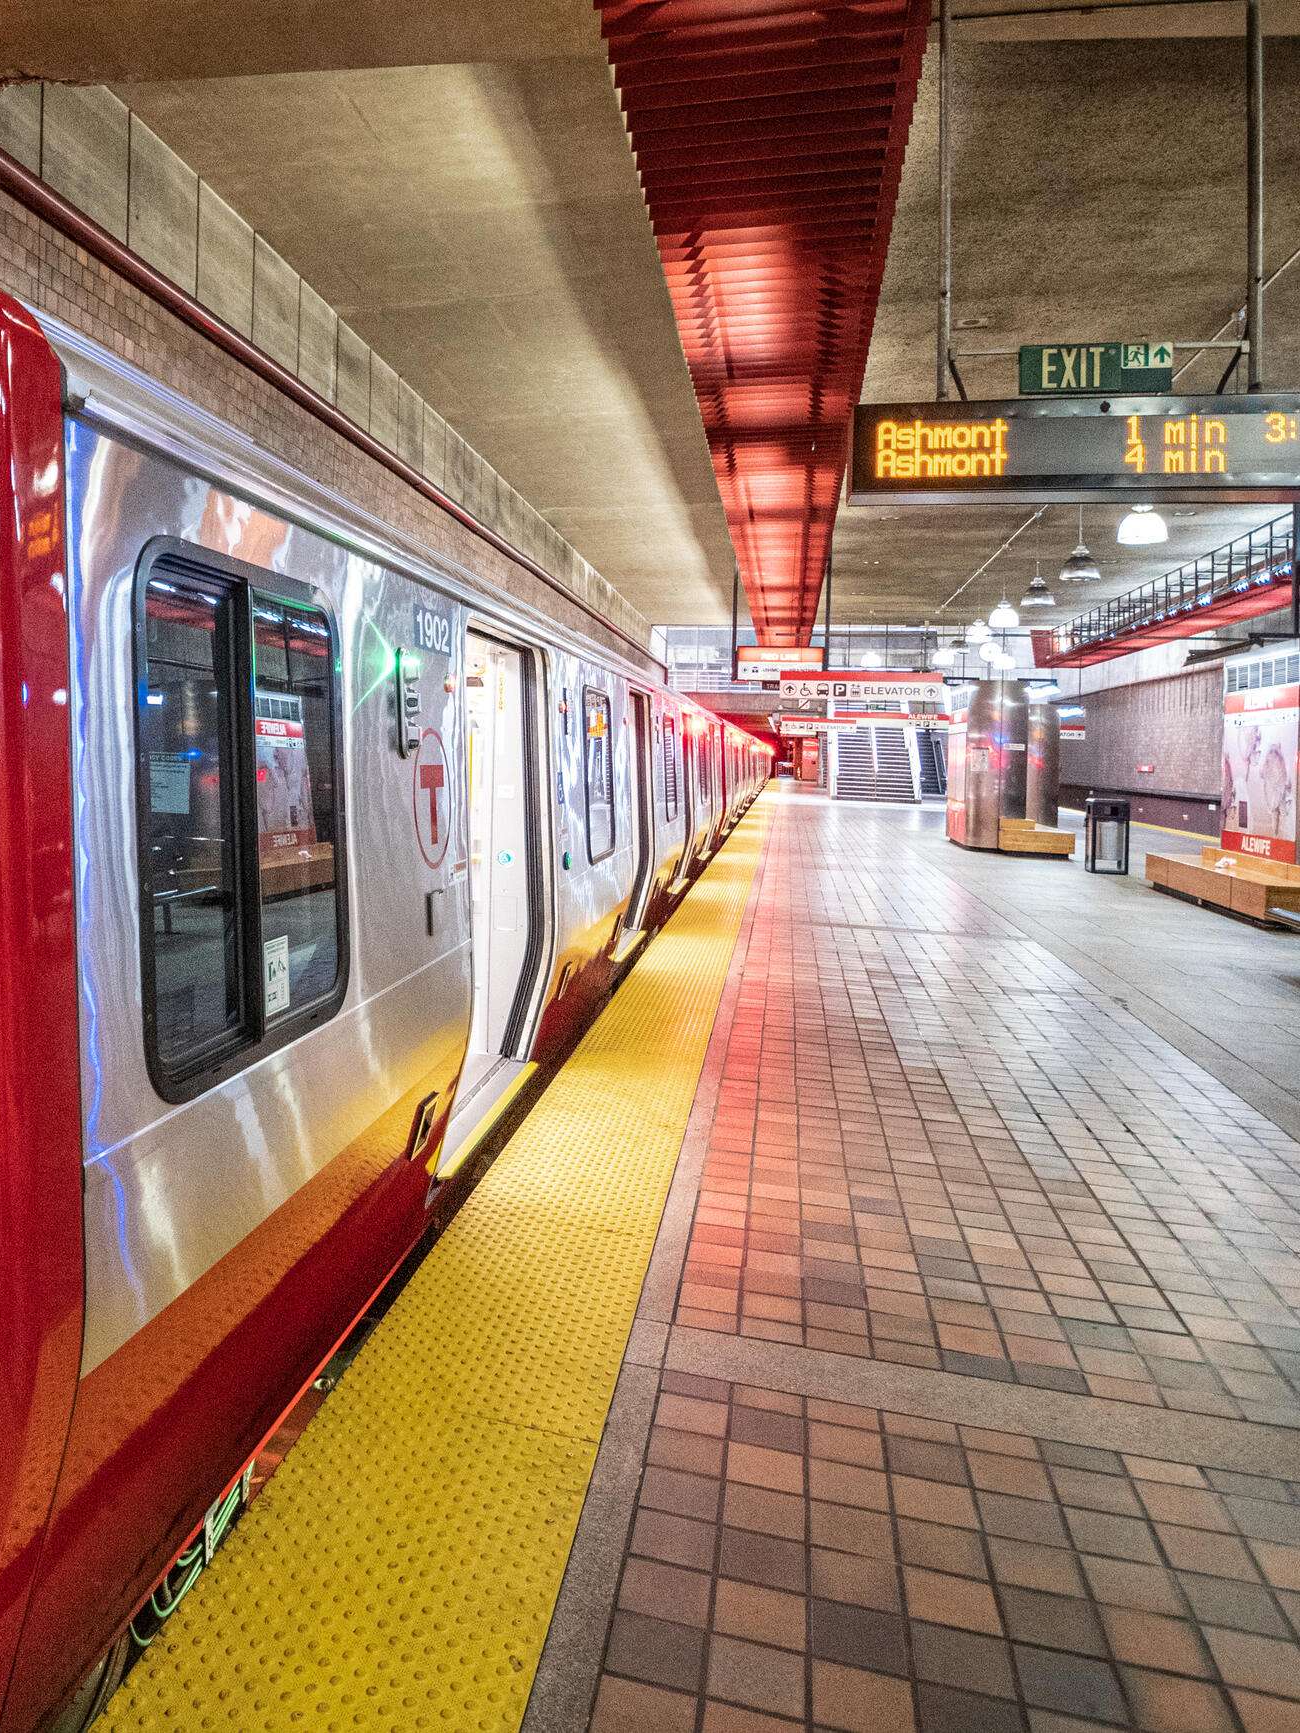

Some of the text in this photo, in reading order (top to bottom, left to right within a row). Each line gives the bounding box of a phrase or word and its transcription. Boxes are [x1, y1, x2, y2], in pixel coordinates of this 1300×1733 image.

[1042, 347, 1105, 388] EXIT
[877, 418, 1009, 449] Ashmont
[1126, 415, 1142, 445] 1
[1164, 414, 1226, 444] min
[876, 443, 1226, 478] Ashmont 4 min
[416, 609, 450, 653] 1902
[863, 686, 921, 696] ELEVATOR
[420, 764, 444, 845] T
[1241, 835, 1271, 856] ALEWIFE
